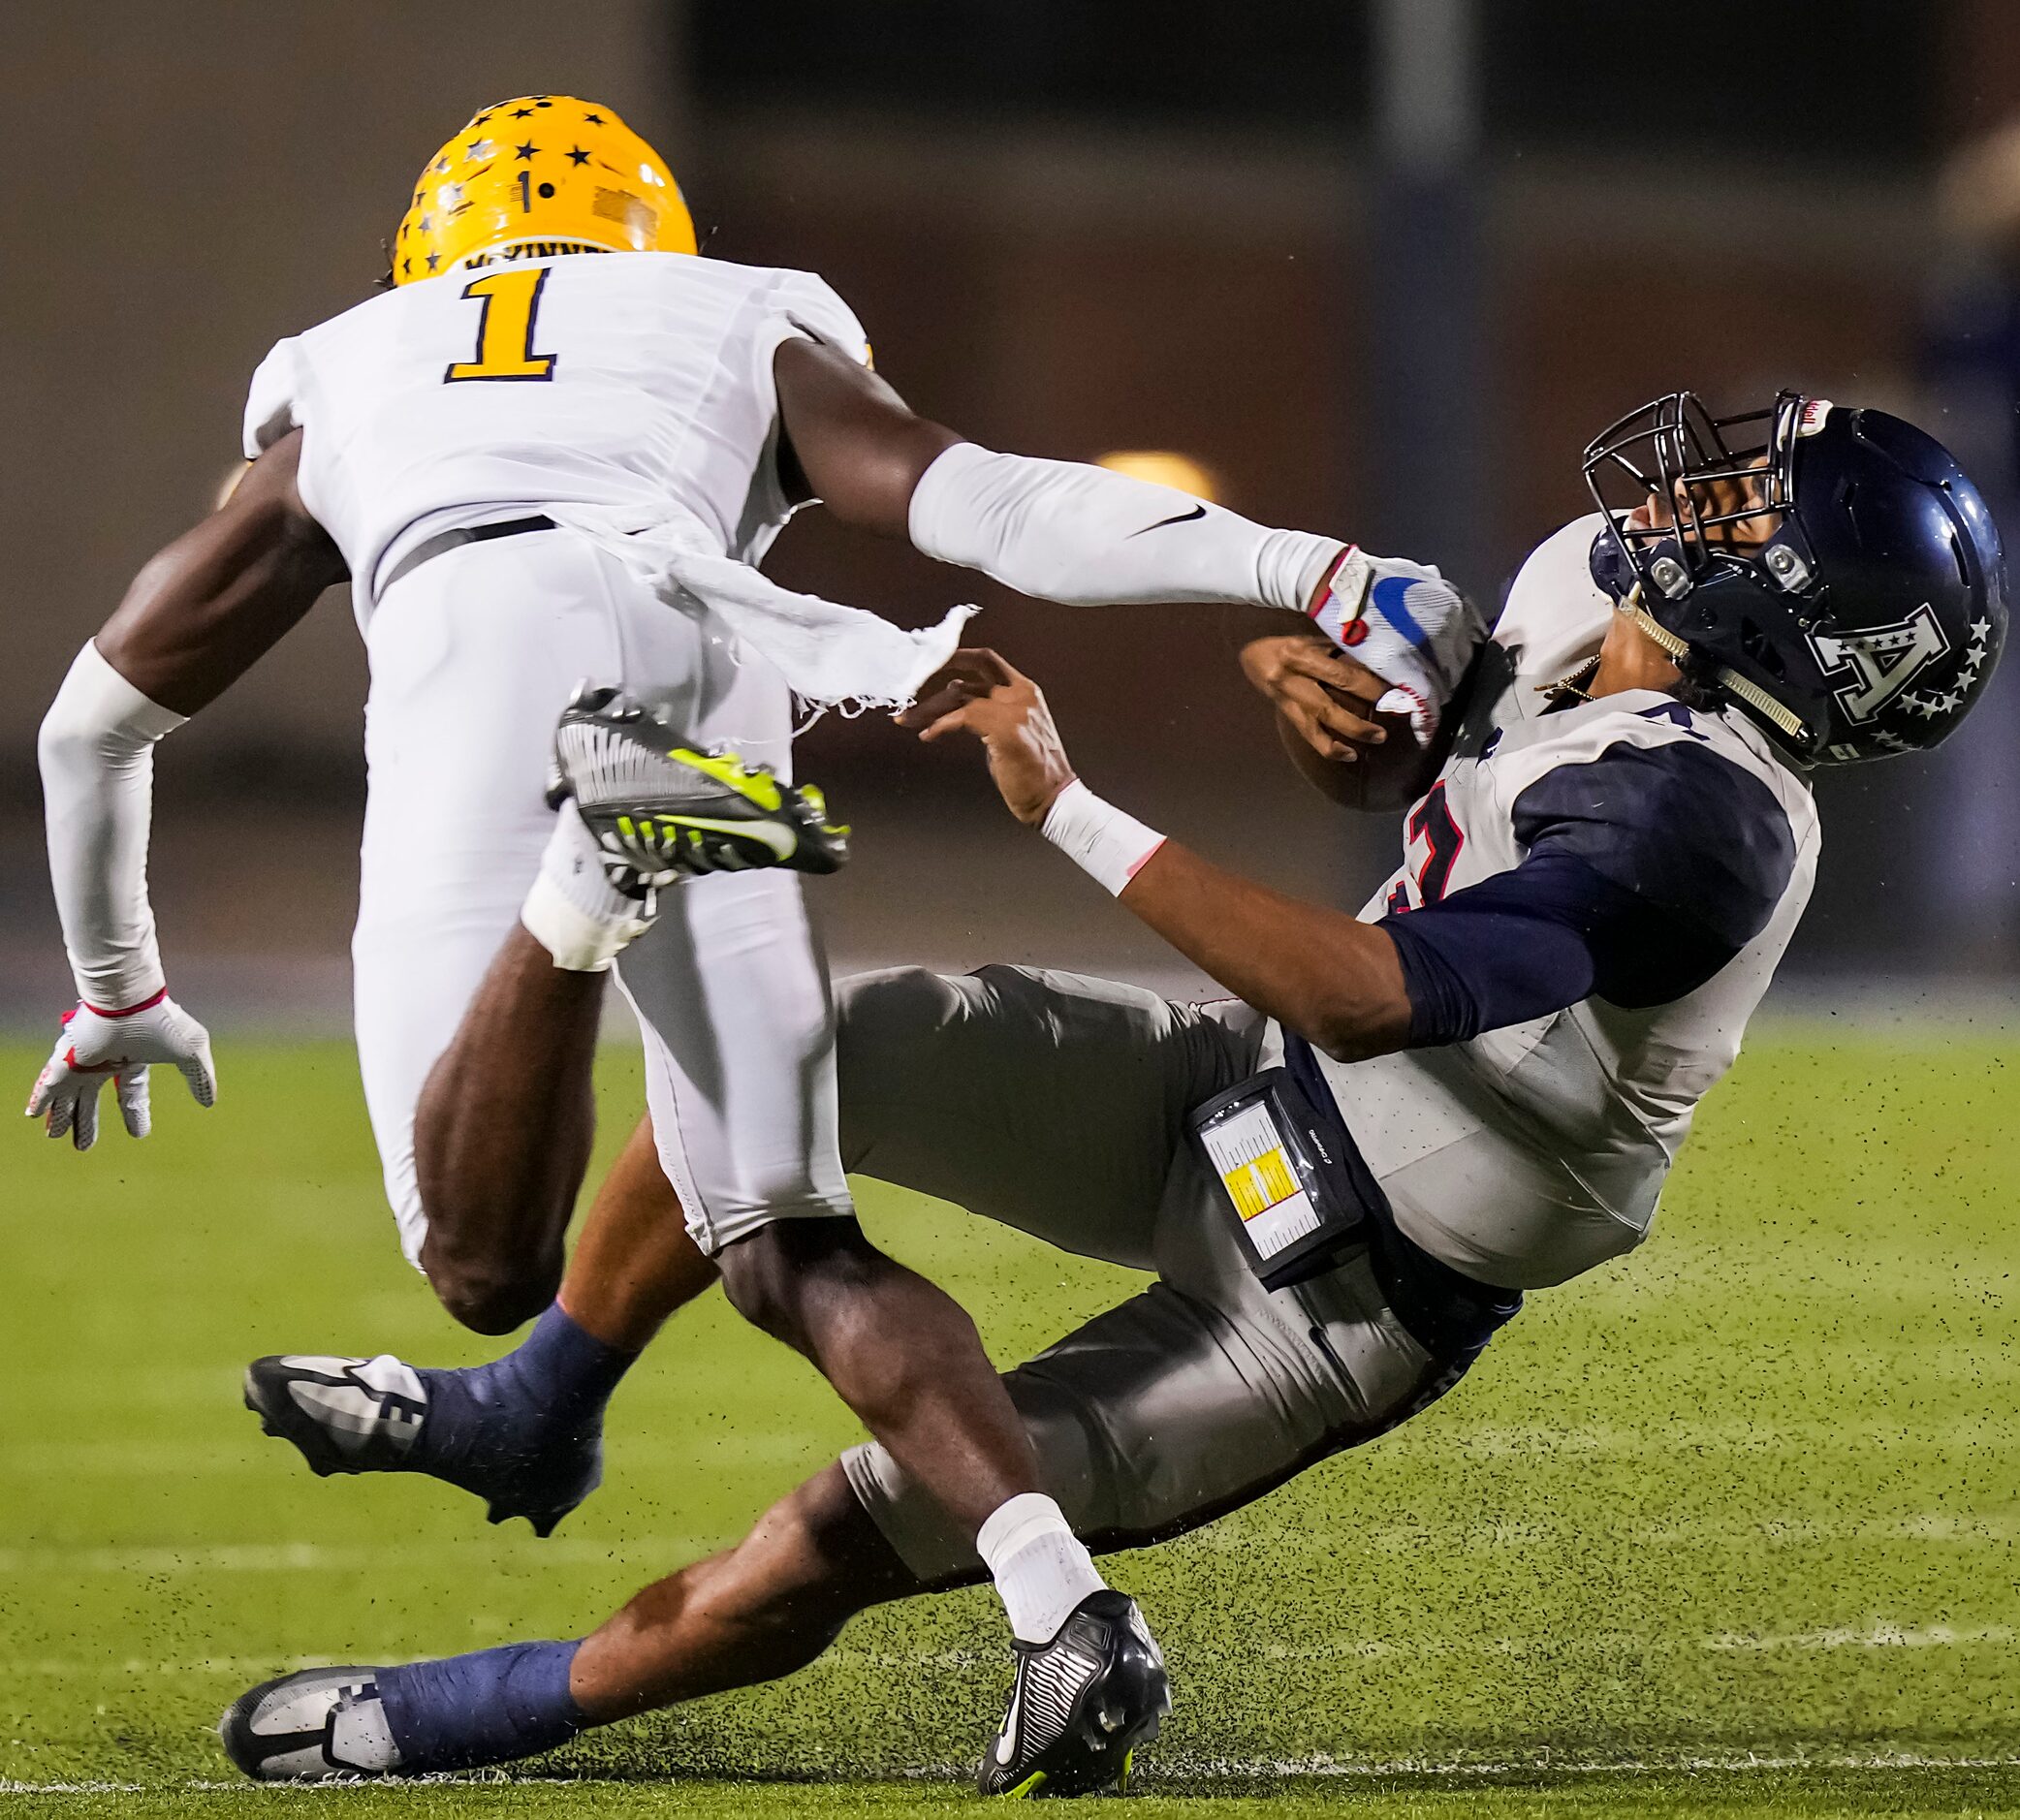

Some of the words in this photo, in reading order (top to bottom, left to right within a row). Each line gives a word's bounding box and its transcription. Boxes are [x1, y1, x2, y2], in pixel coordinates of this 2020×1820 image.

[518, 171, 530, 213] 1
[443, 267, 558, 384] 1
[1804, 602, 1951, 727] A
